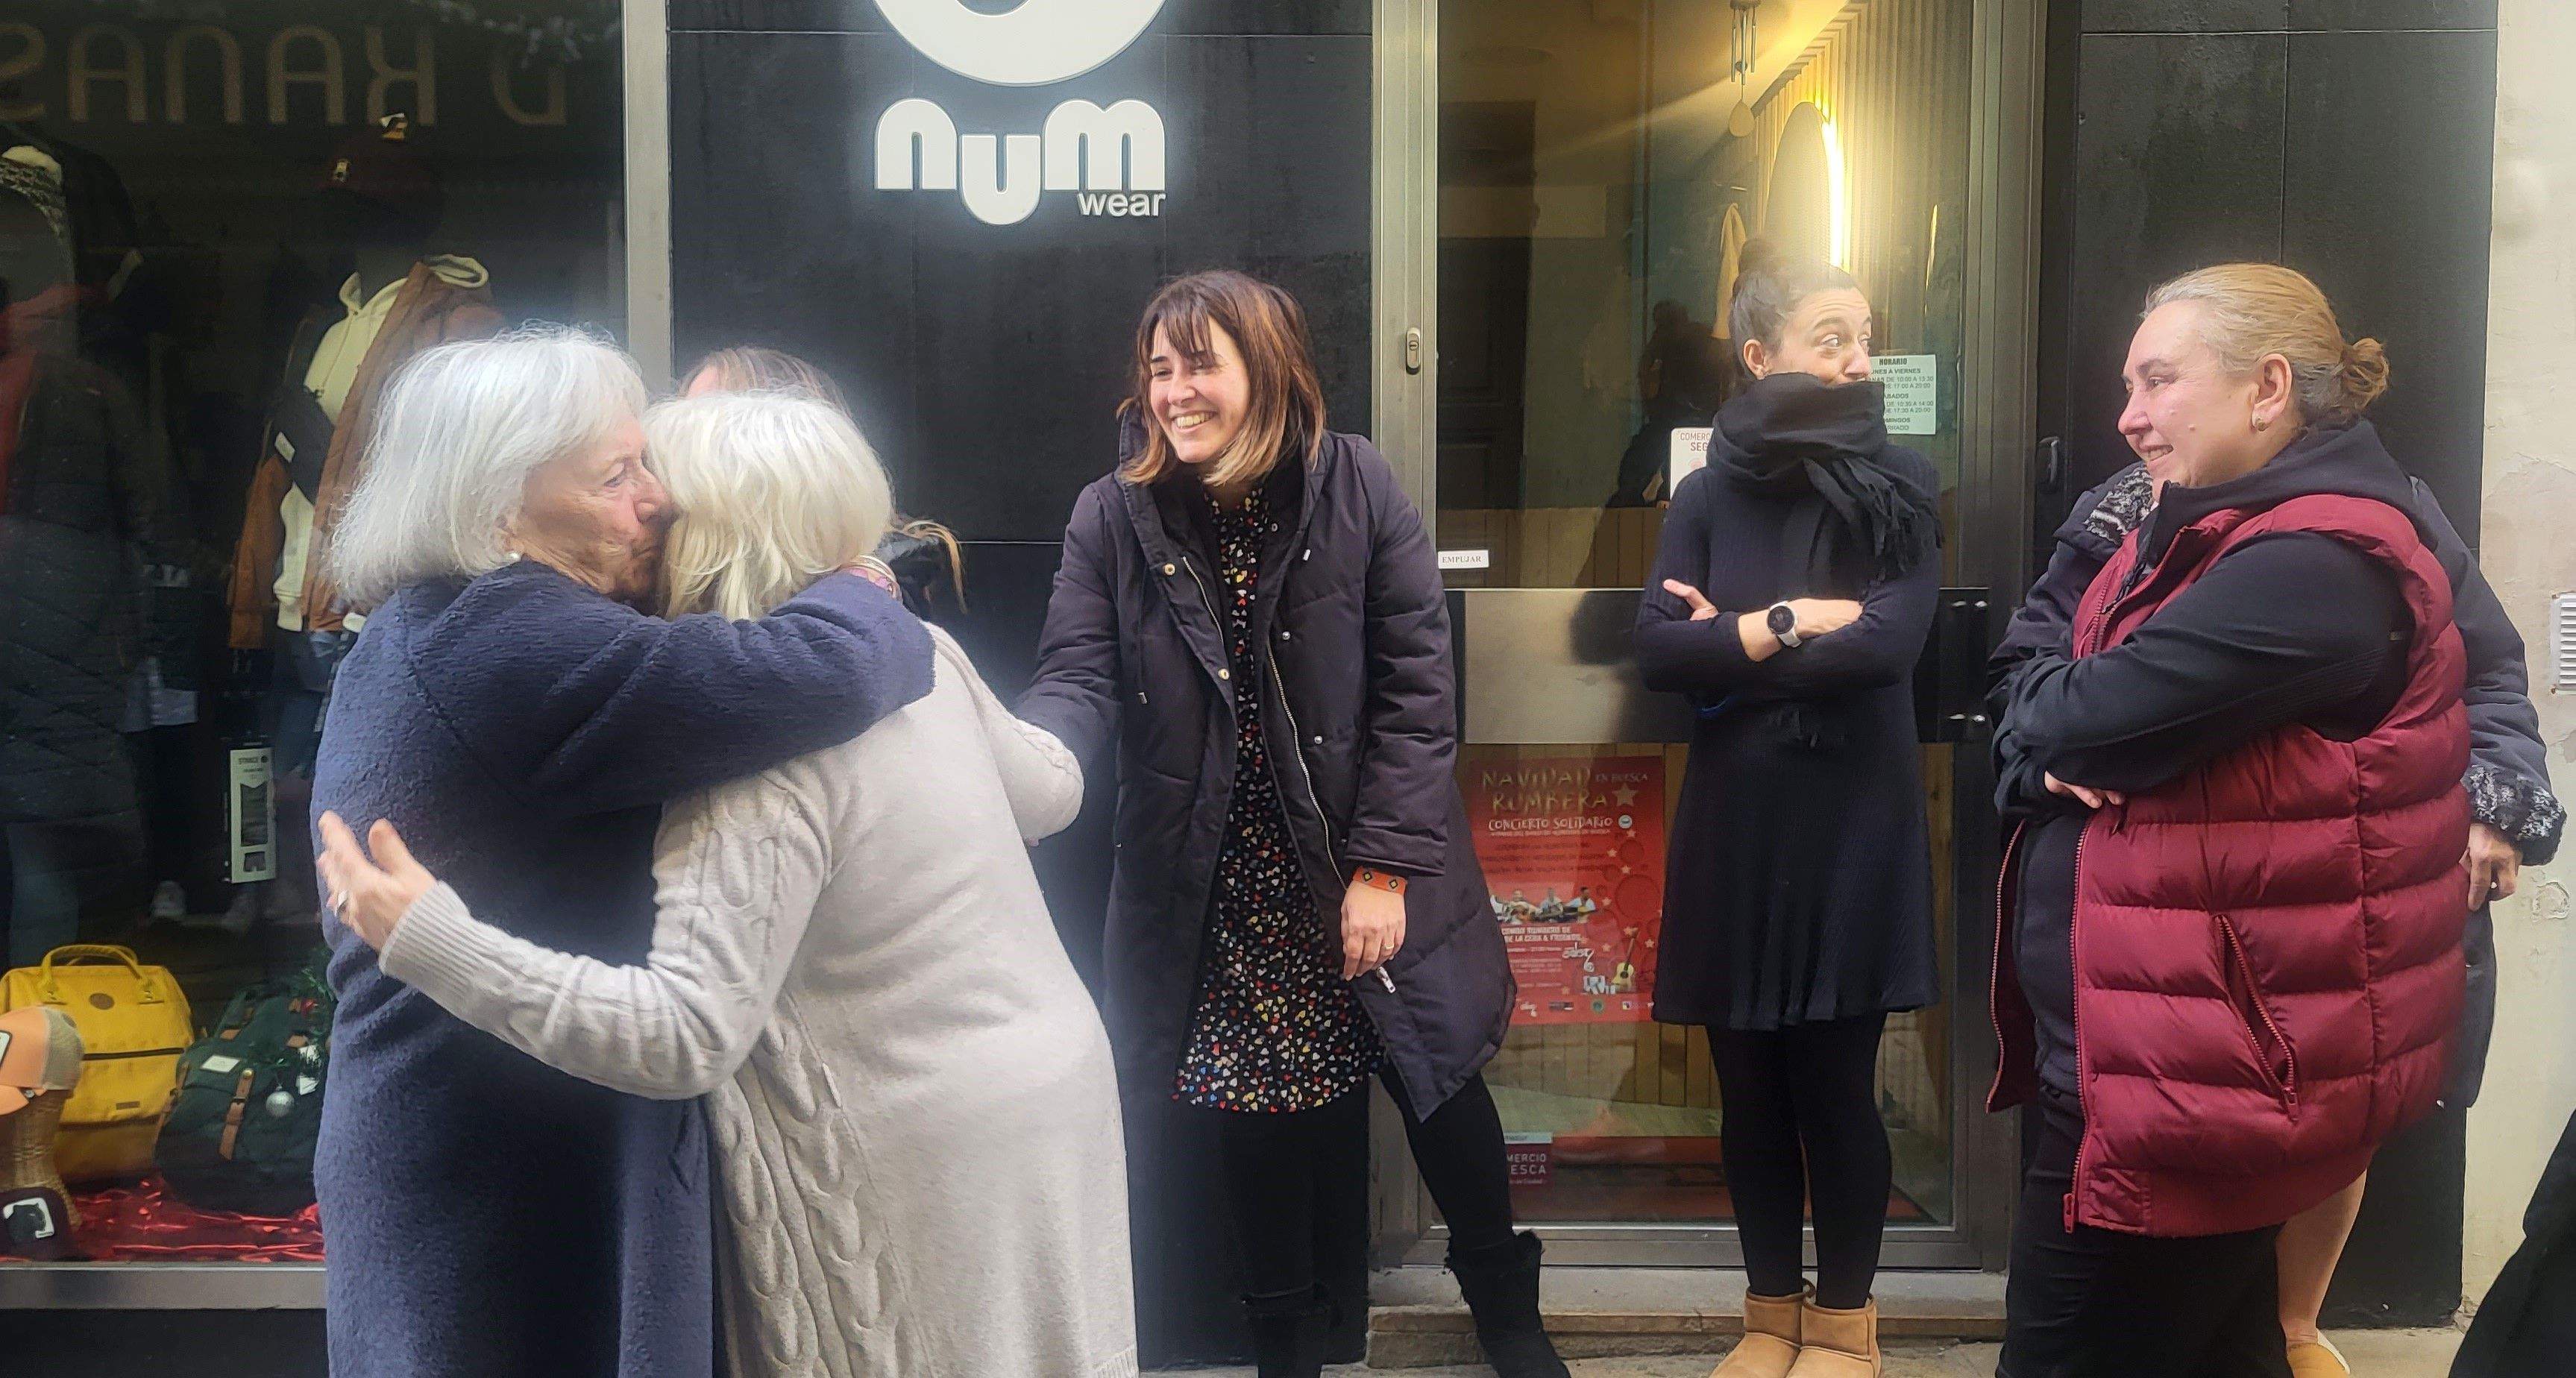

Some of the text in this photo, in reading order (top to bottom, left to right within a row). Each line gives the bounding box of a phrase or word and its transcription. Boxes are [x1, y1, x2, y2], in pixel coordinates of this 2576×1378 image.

[874, 97, 1166, 225] num
[1077, 191, 1166, 218] wear
[1680, 432, 1711, 441] COMERC
[1690, 442, 1708, 451] SEG
[1482, 768, 1591, 790] NAVIDAD
[1488, 816, 1613, 831] CONCIERTO SOLIDARIO
[1507, 1154, 1546, 1163] MERCIO
[1510, 1164, 1546, 1174] ESCA
